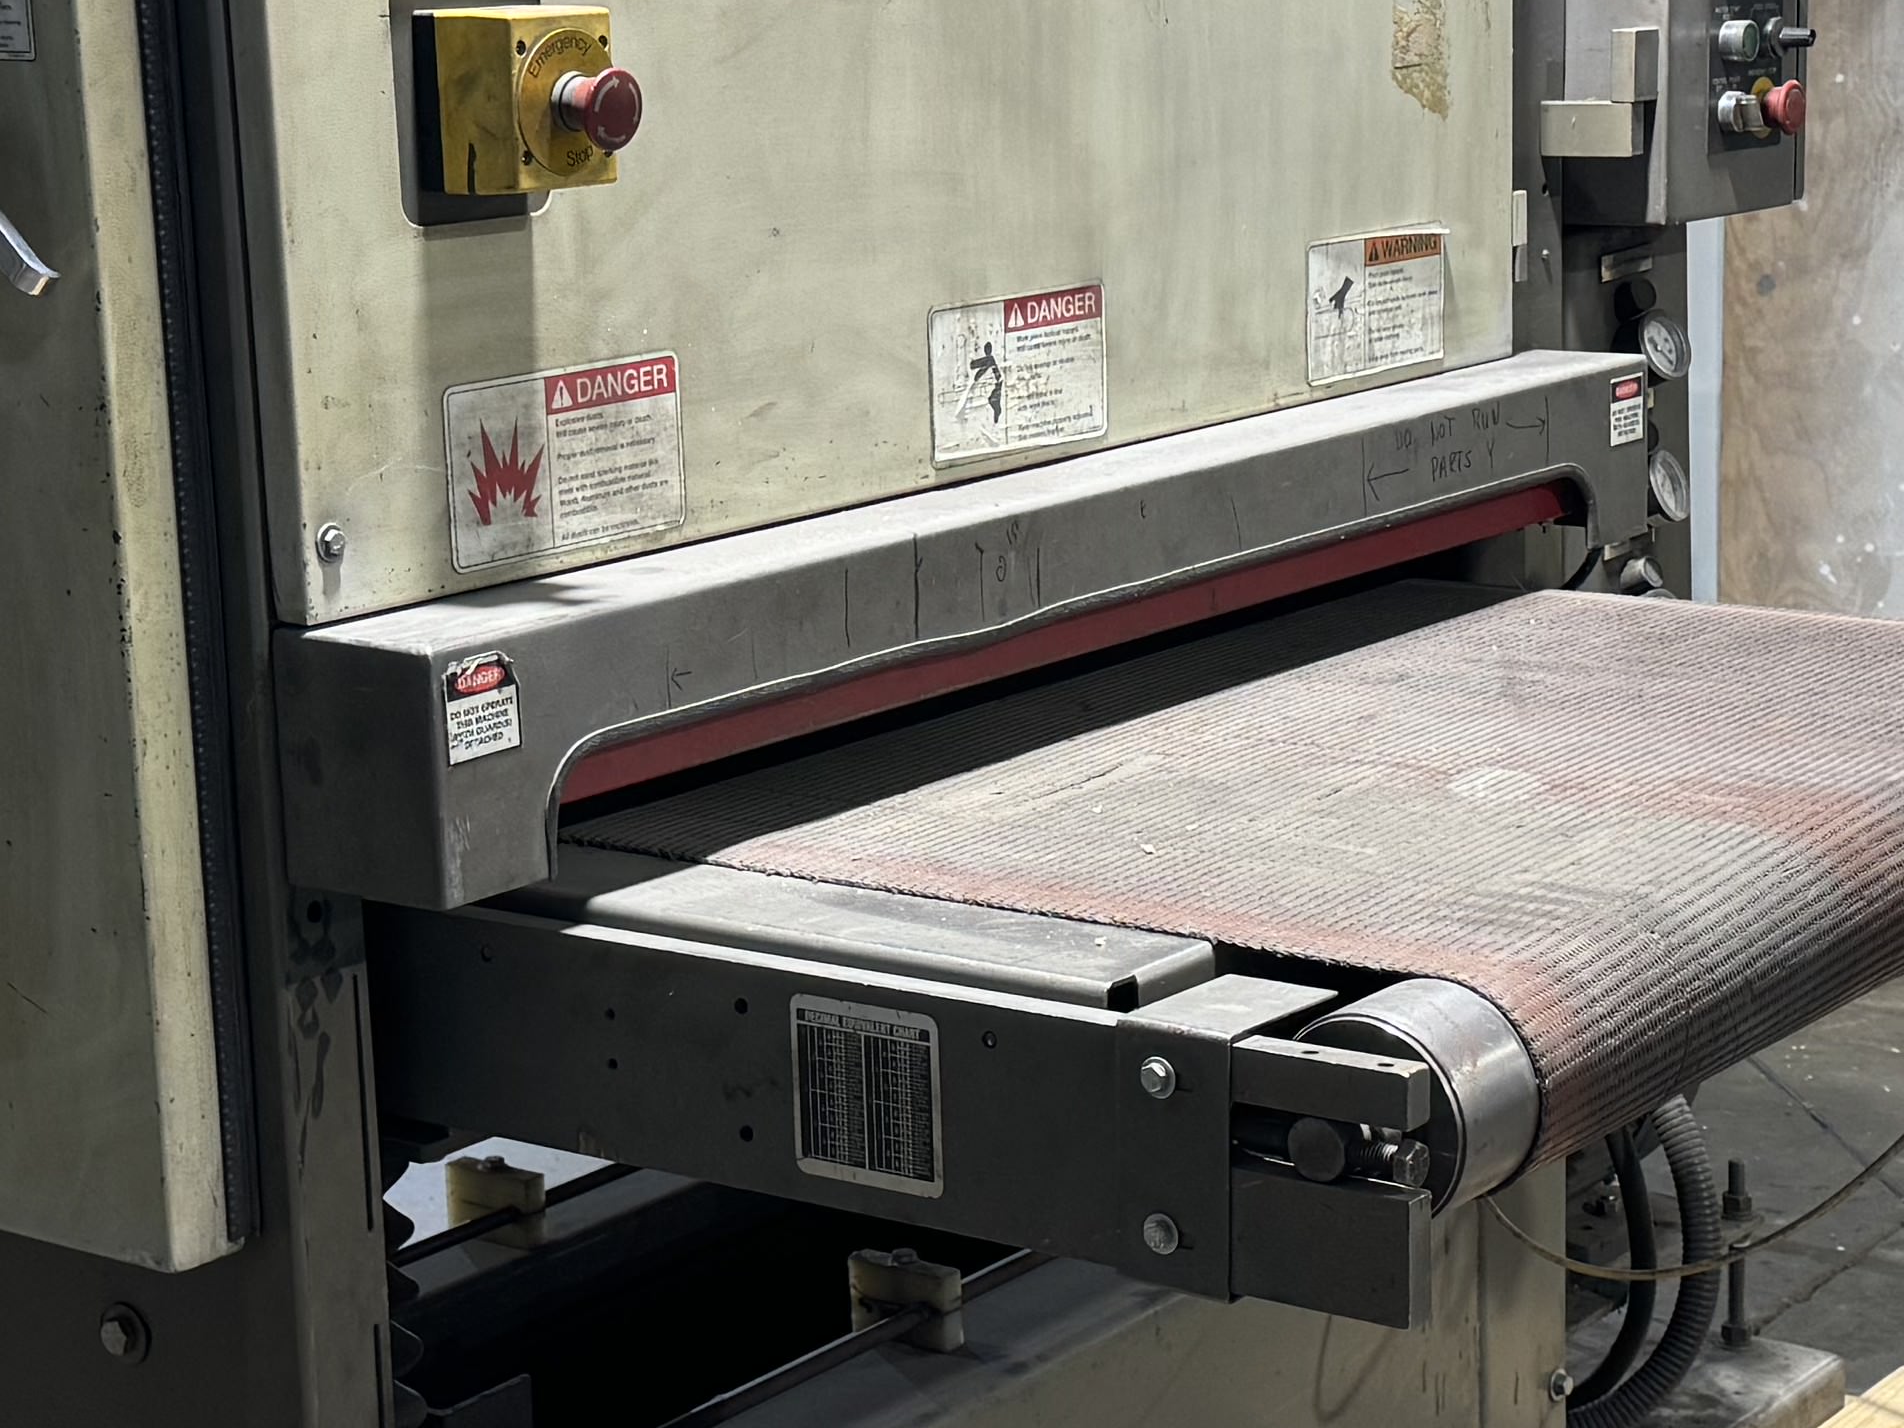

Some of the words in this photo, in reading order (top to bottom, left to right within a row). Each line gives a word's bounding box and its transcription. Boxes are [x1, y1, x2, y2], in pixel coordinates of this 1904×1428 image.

[528, 35, 592, 78] Emergency
[566, 144, 594, 168] Stop
[1381, 233, 1438, 259] WARNING
[1027, 292, 1096, 324] DANGER
[576, 364, 668, 404] DANGER
[1430, 416, 1455, 447] NOT
[1471, 400, 1501, 432] RUN
[1431, 449, 1473, 483] PARTS
[450, 711, 461, 720] DO
[805, 1009, 840, 1026] DECIMAL
[843, 1017, 891, 1035] EQUIVALENT
[893, 1026, 920, 1039] CHART
